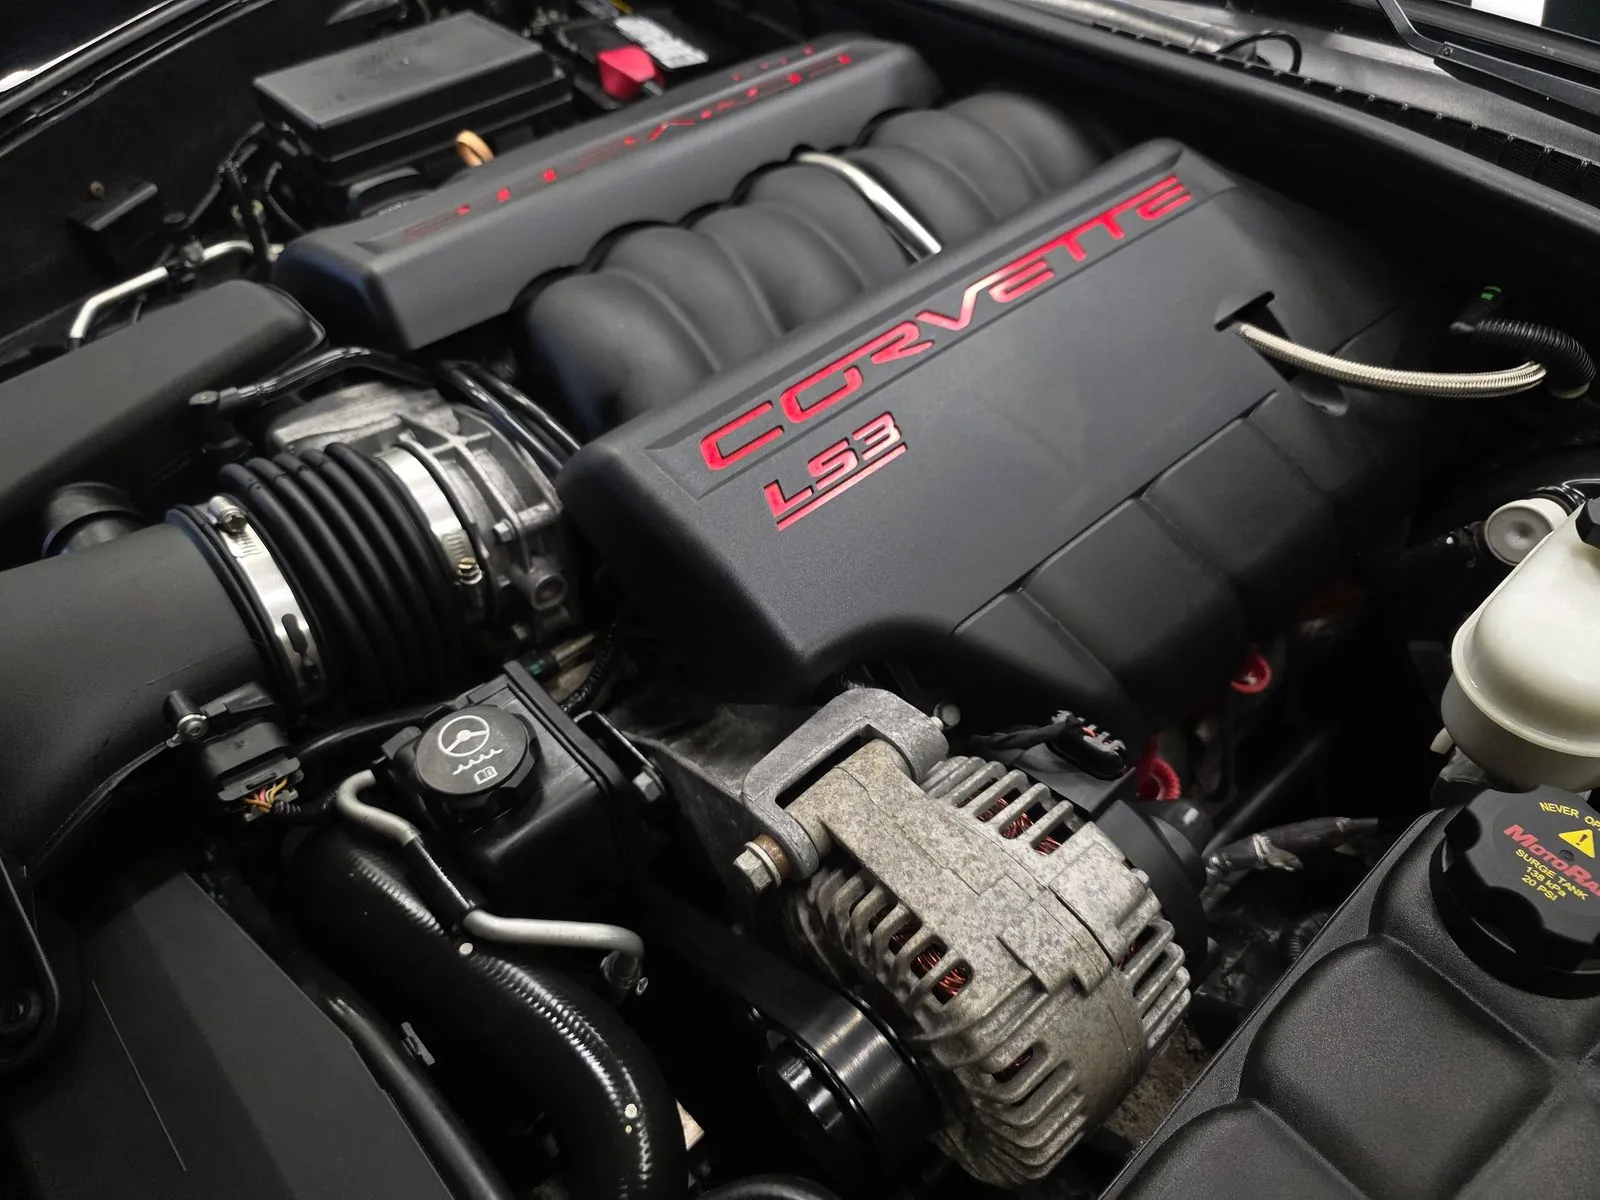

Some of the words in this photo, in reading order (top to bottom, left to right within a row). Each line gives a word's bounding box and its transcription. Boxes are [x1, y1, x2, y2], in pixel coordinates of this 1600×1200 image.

[700, 175, 1192, 471] CORVETTE
[763, 411, 903, 517] LS3
[1538, 801, 1579, 819] NEVER
[1584, 816, 1600, 831] OP
[1504, 824, 1600, 897] MOTORA
[1516, 848, 1557, 879] SURGE
[1558, 876, 1589, 901] TANK
[1526, 866, 1546, 882] 138
[1545, 880, 1567, 897] kPa
[1521, 874, 1537, 887] 20
[1537, 884, 1558, 902] PSI
